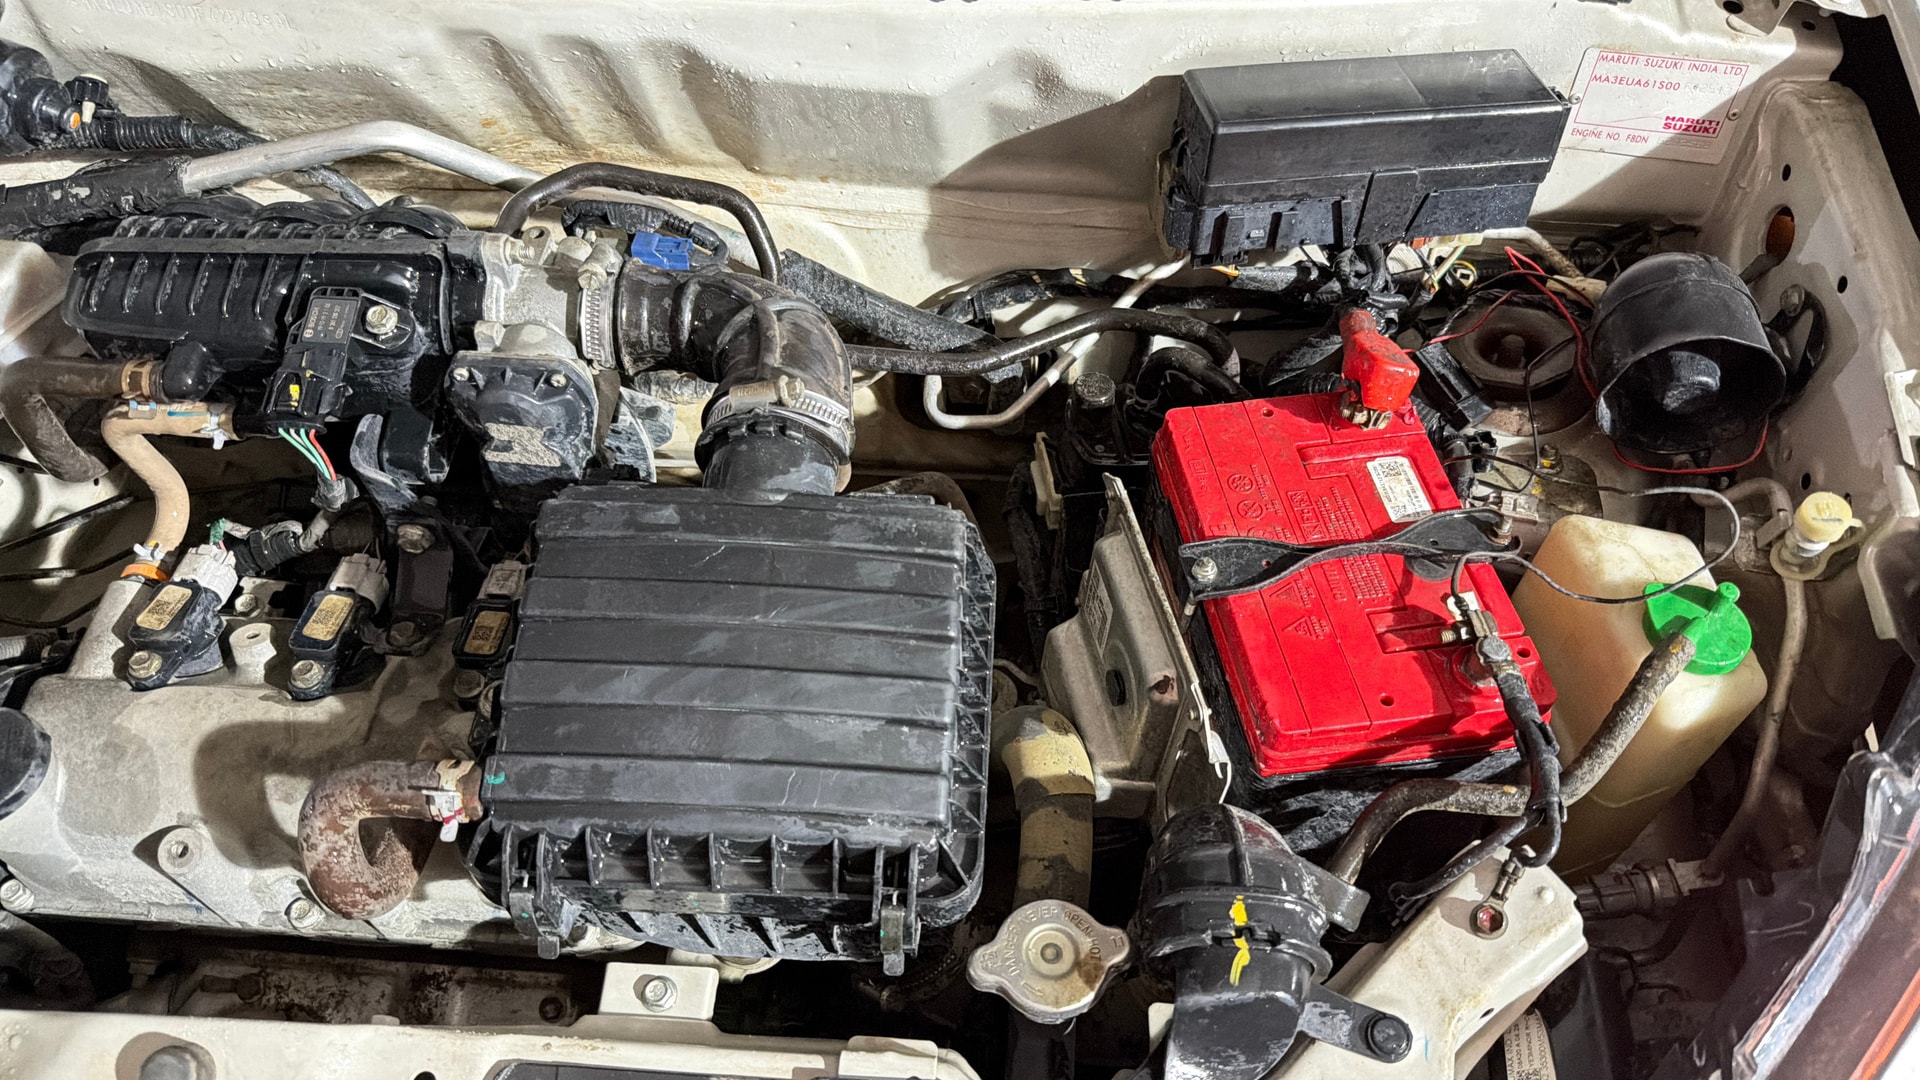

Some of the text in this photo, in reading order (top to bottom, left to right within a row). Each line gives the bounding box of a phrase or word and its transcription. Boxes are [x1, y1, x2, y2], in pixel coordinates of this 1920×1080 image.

[1599, 54, 1640, 66] MARUTI
[1643, 58, 1684, 70] SUZUKI
[1687, 62, 1718, 74] INDIA
[1664, 115, 1721, 127] MARUTI
[1570, 127, 1604, 139] ENGINE
[1661, 122, 1719, 135] SUZUKI
